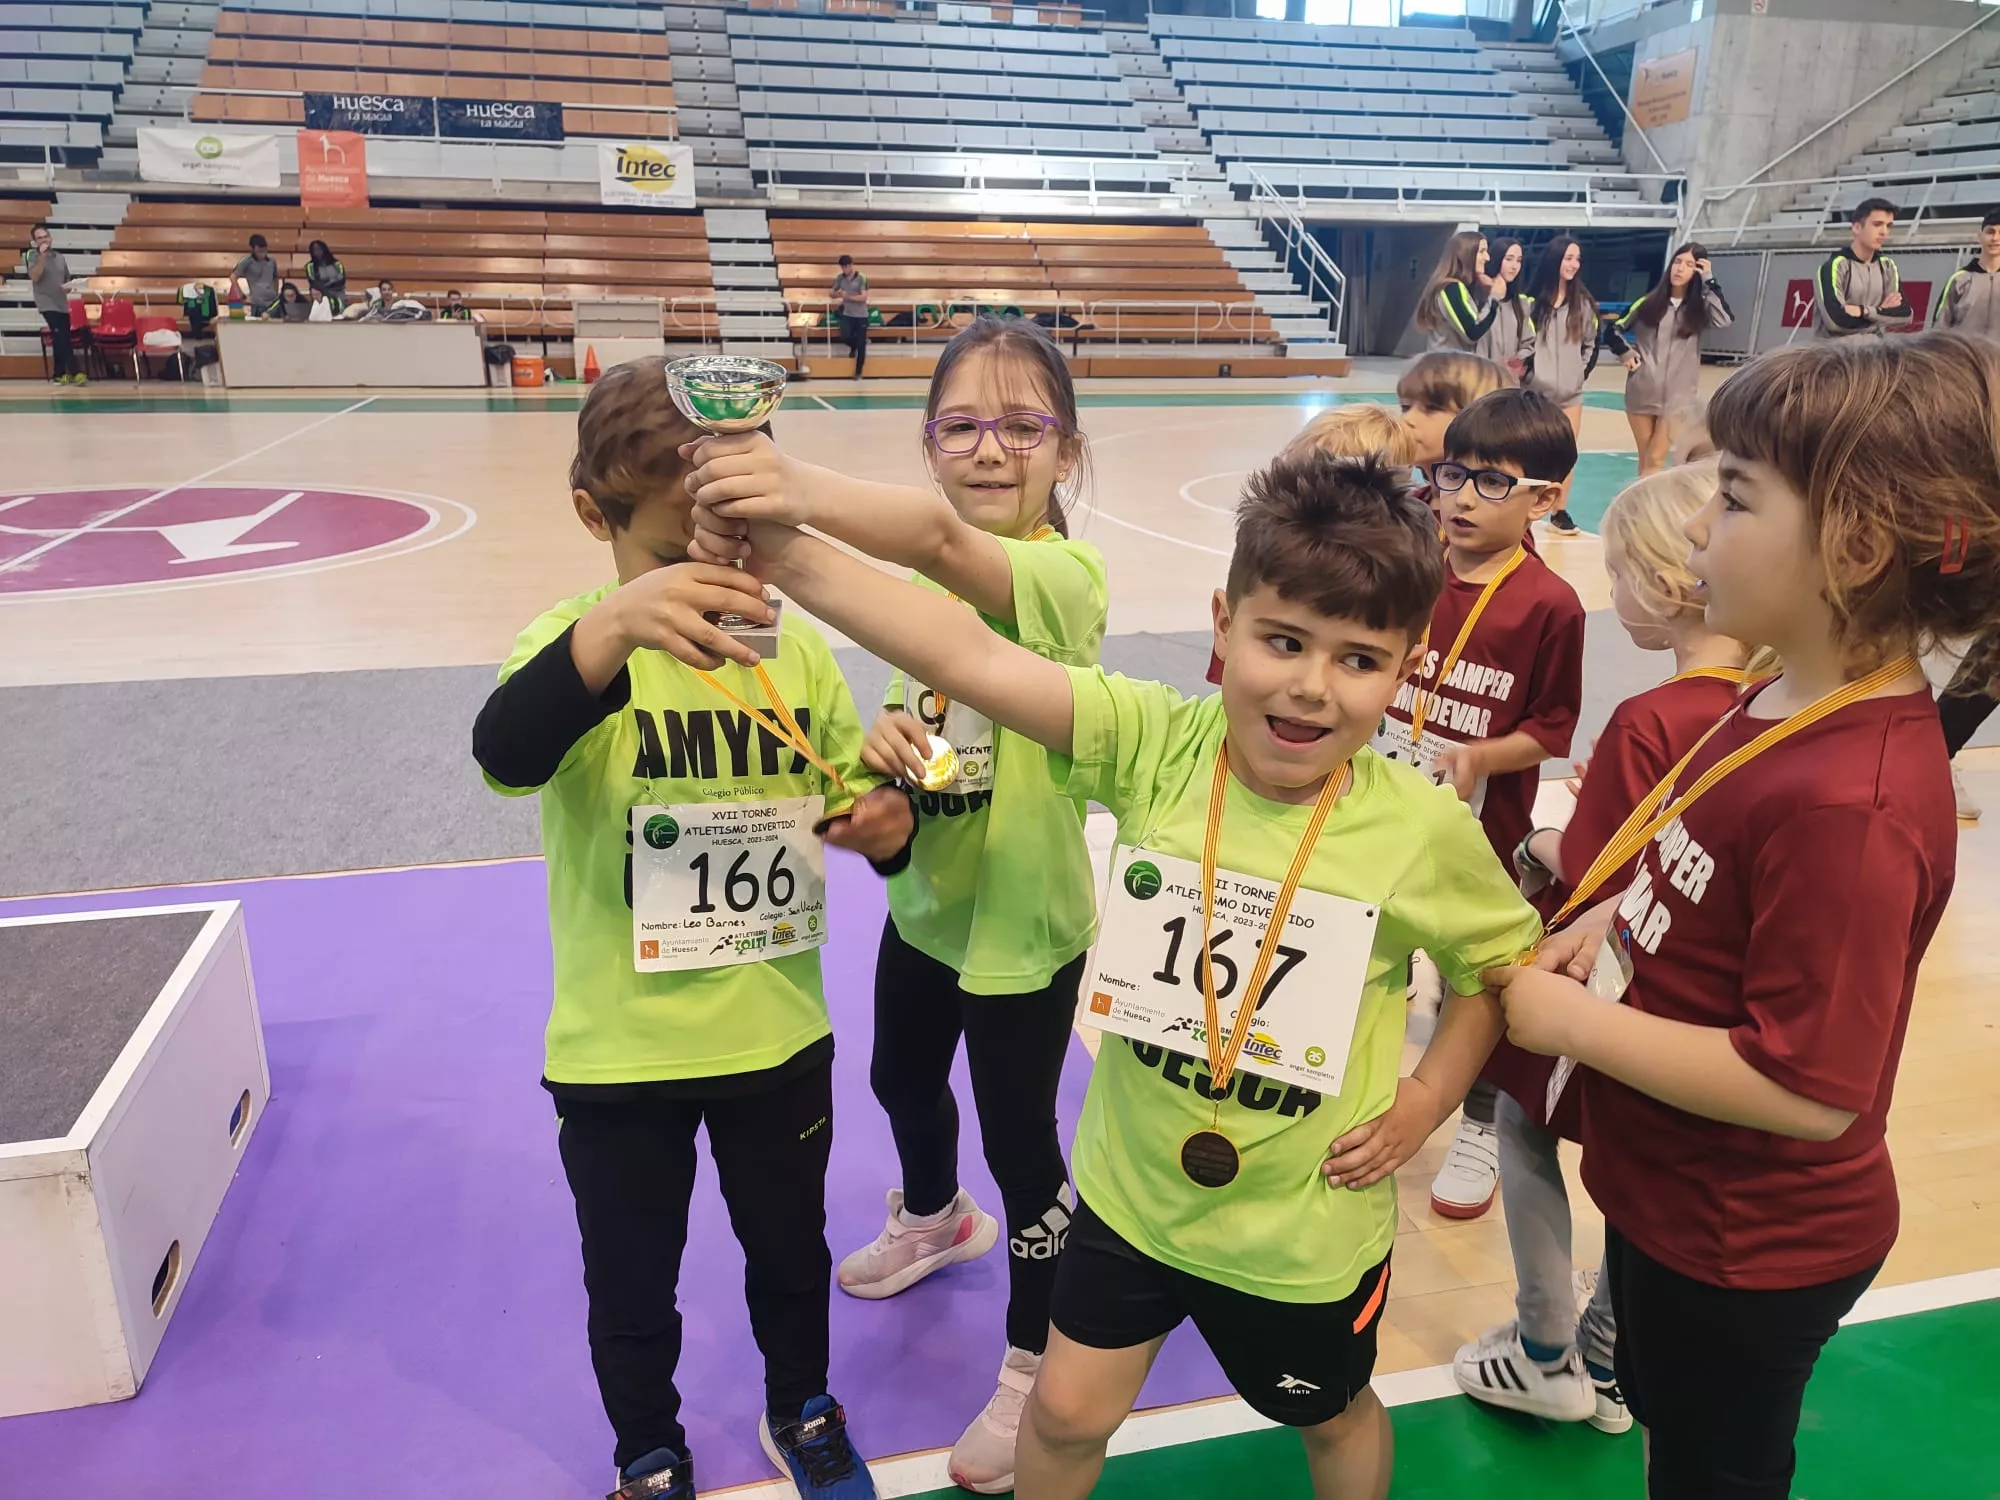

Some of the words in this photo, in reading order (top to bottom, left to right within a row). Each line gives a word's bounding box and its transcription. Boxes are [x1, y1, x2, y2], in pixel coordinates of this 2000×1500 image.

[712, 811, 738, 820] XVII
[742, 808, 777, 819] TORNEO
[684, 825, 748, 836] ATLETISMO
[751, 820, 796, 833] DIVERTIDO
[689, 845, 795, 914] 166
[1233, 882, 1278, 903] TORNE
[1165, 884, 1238, 910] ATLETSMO
[1242, 902, 1315, 929] DIVEIDO
[1192, 904, 1229, 923] HUSCA,
[641, 922, 682, 931] Nombre:
[683, 918, 702, 929] Leo
[705, 916, 746, 928] Barnes
[1152, 916, 1307, 1011] 167
[1098, 972, 1141, 991] Nombre:
[1112, 1007, 1122, 1015] de
[1123, 1008, 1151, 1023] Huesca
[1114, 997, 1166, 1018] Ayuntamiento
[1308, 1050, 1322, 1063] as
